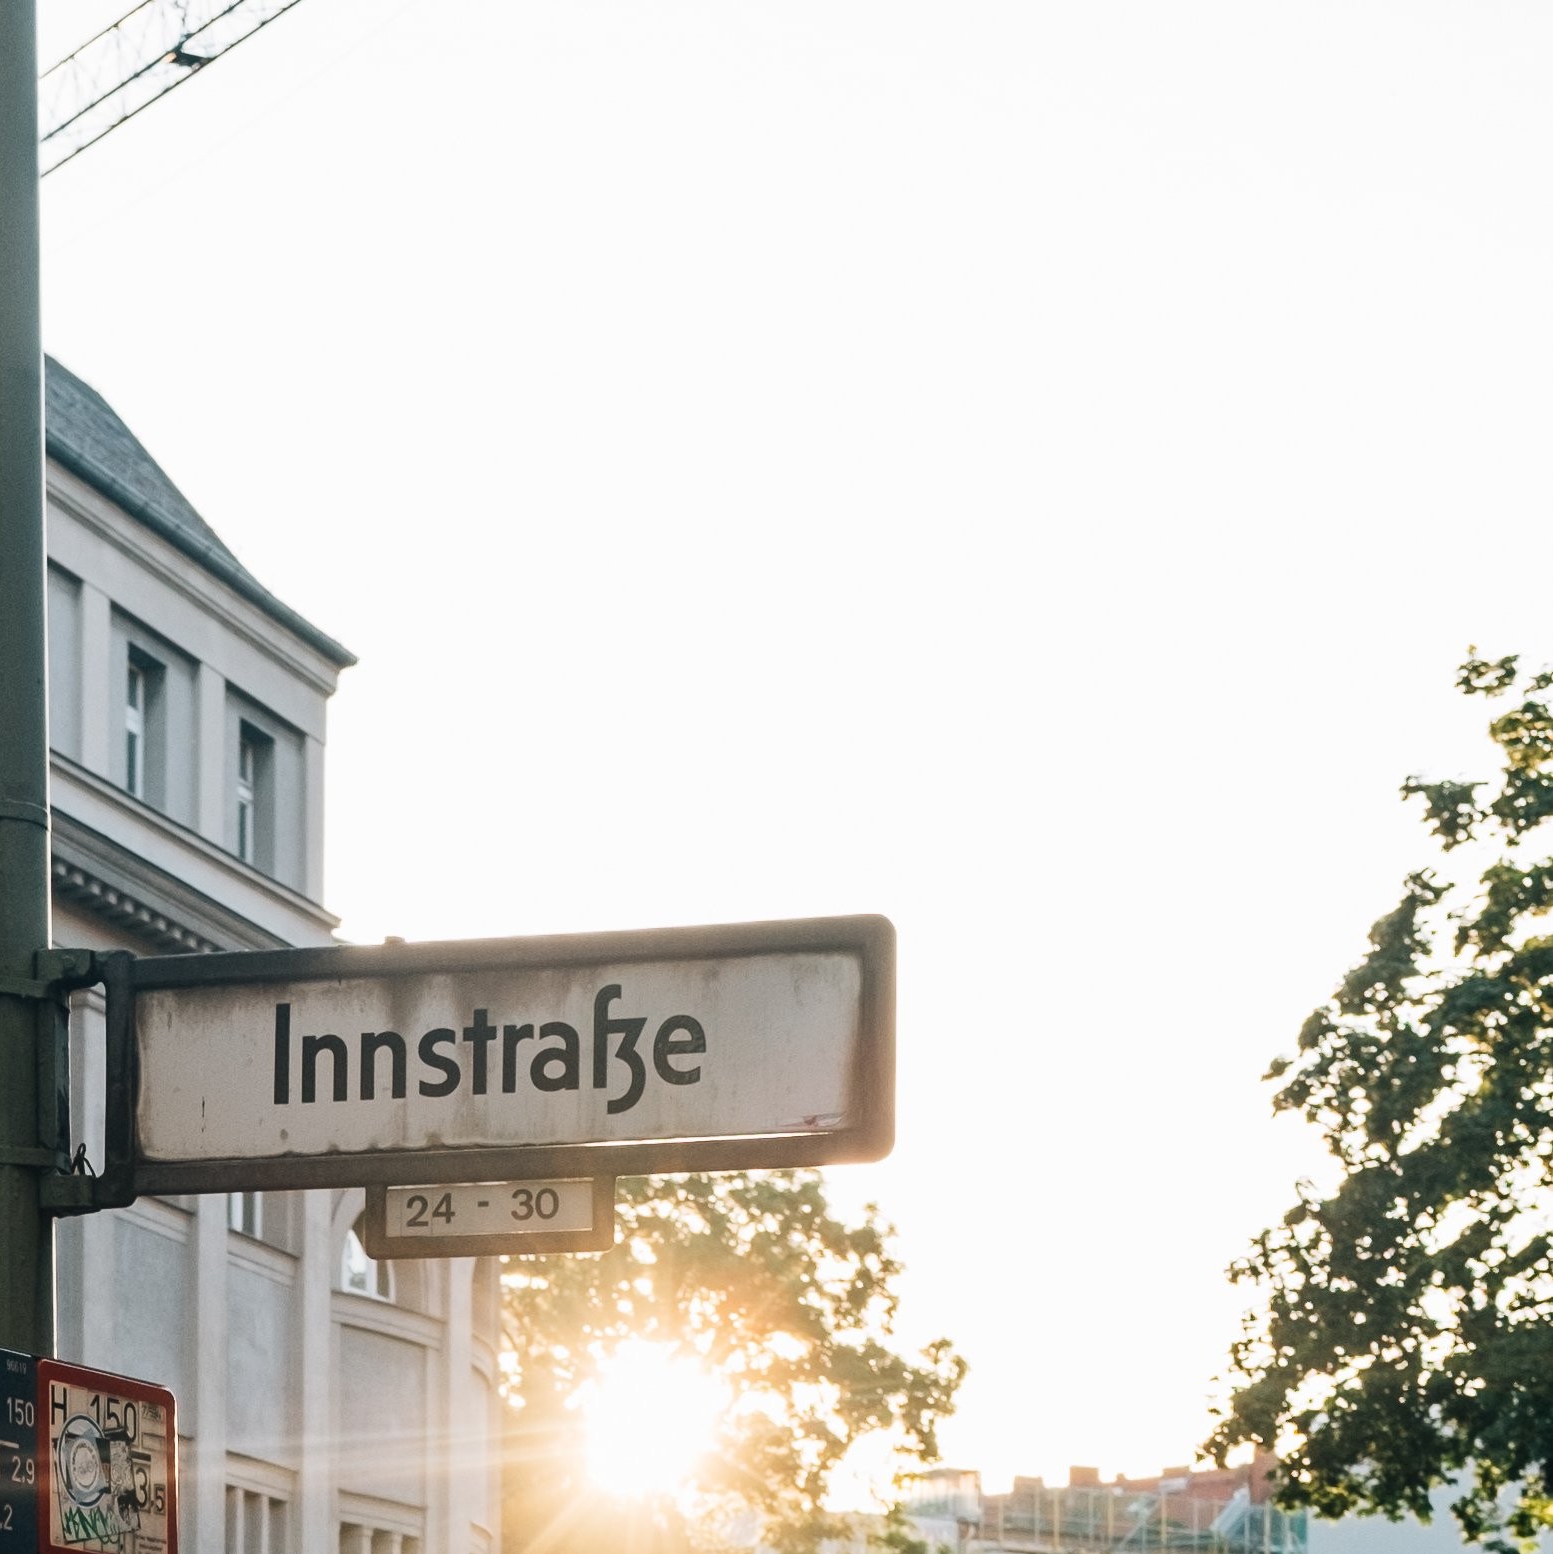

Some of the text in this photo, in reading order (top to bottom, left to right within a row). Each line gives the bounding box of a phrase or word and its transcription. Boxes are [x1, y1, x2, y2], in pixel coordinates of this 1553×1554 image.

[274, 984, 707, 1115] Innstraße
[405, 1193, 456, 1228] 24
[511, 1187, 560, 1223] 30
[7, 1396, 35, 1428] 150
[51, 1384, 137, 1442] H 150
[12, 1456, 35, 1485] 2,9
